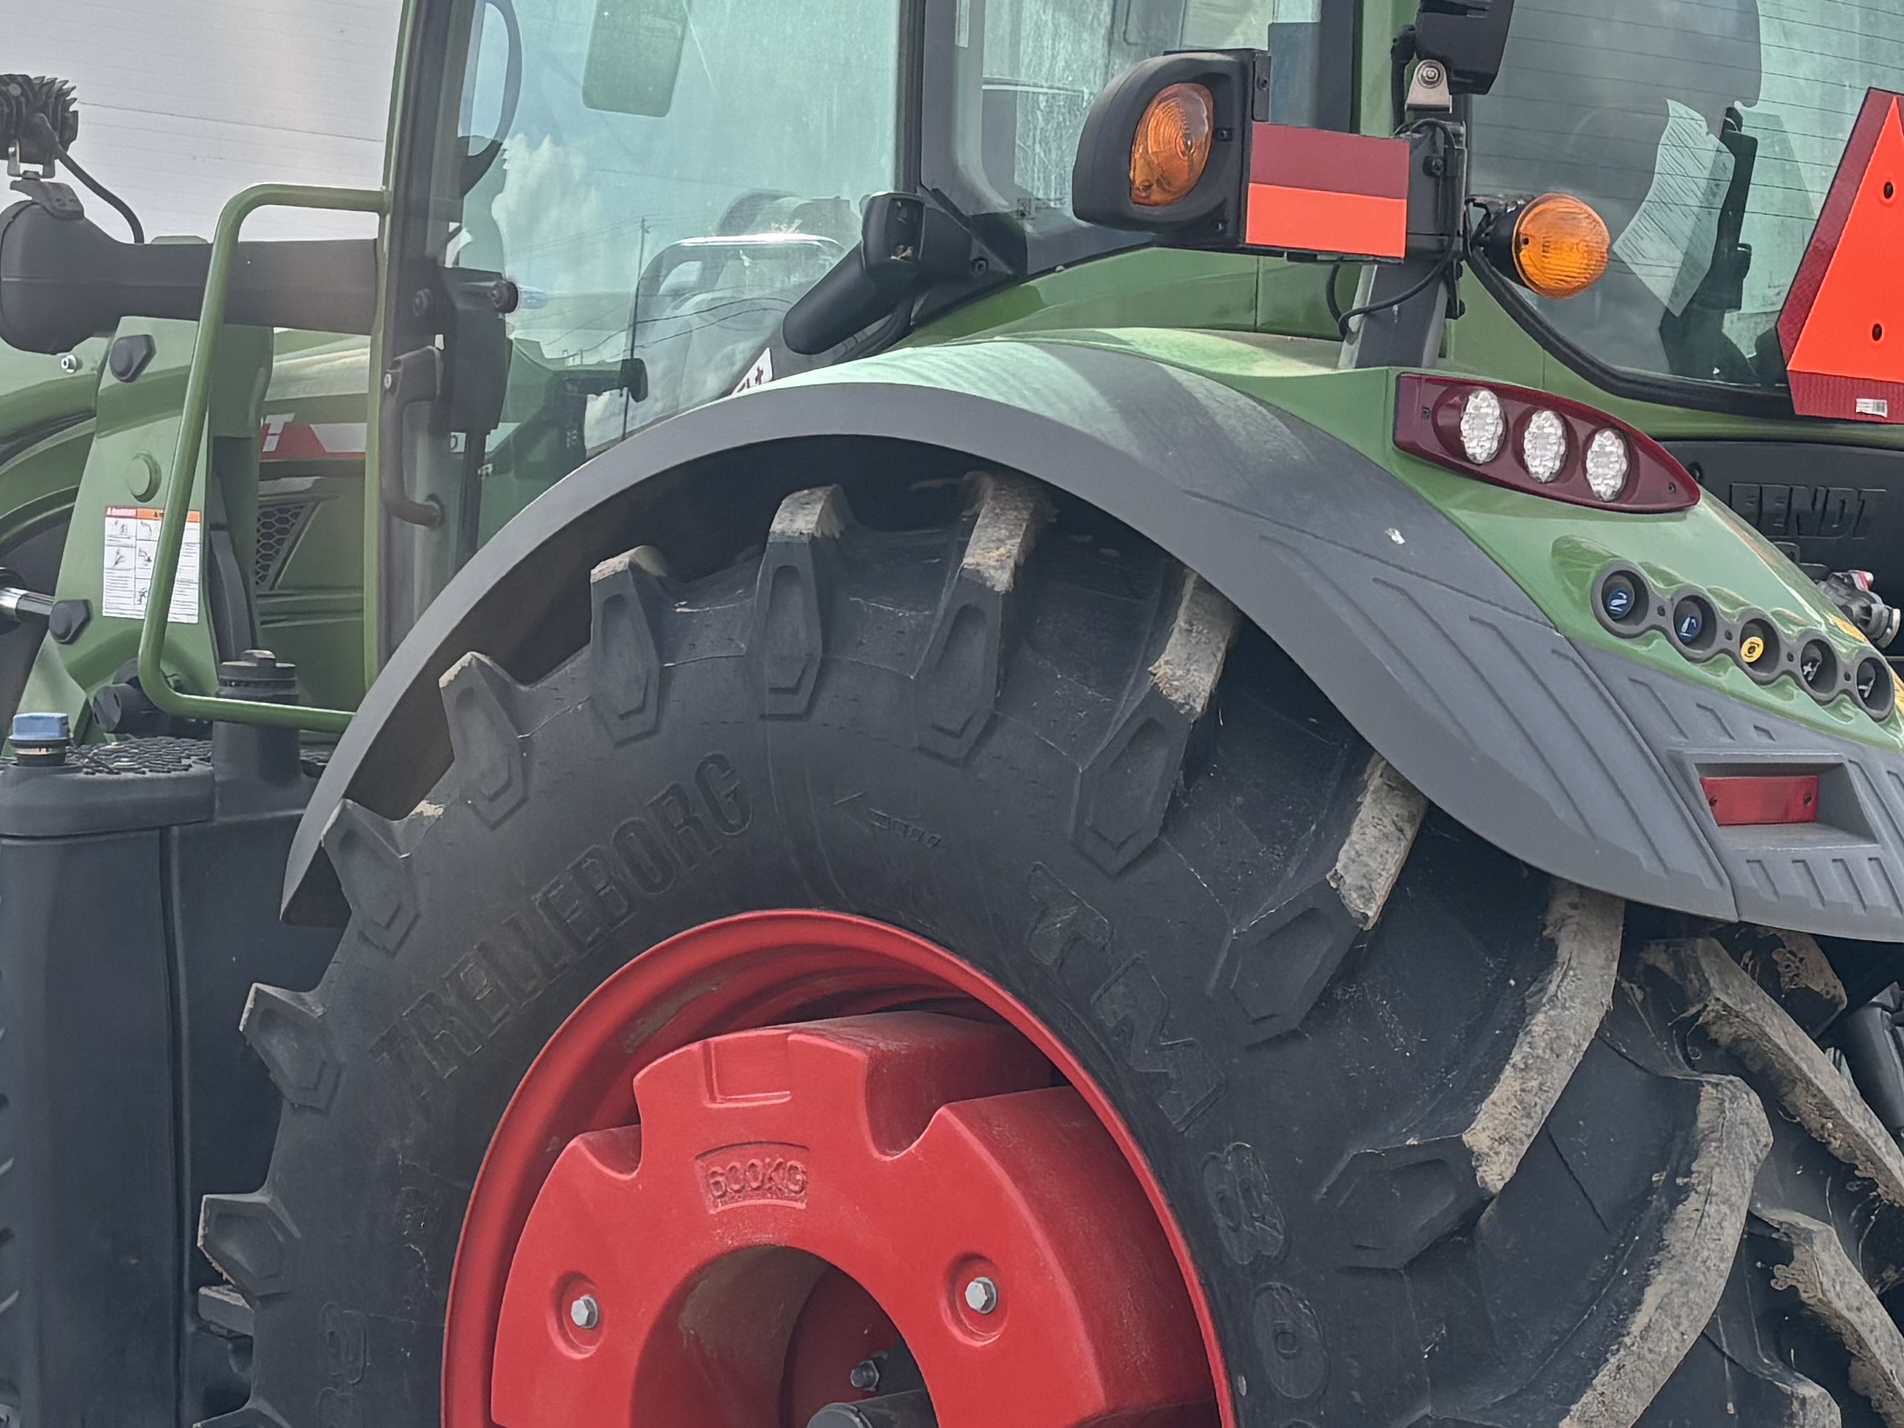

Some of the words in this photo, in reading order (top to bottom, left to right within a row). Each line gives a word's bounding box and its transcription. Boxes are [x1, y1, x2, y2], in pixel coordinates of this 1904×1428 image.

[1730, 482, 1888, 540] FENDT
[368, 751, 756, 1102] TRELLEBORG
[708, 1158, 807, 1199] 600KG
